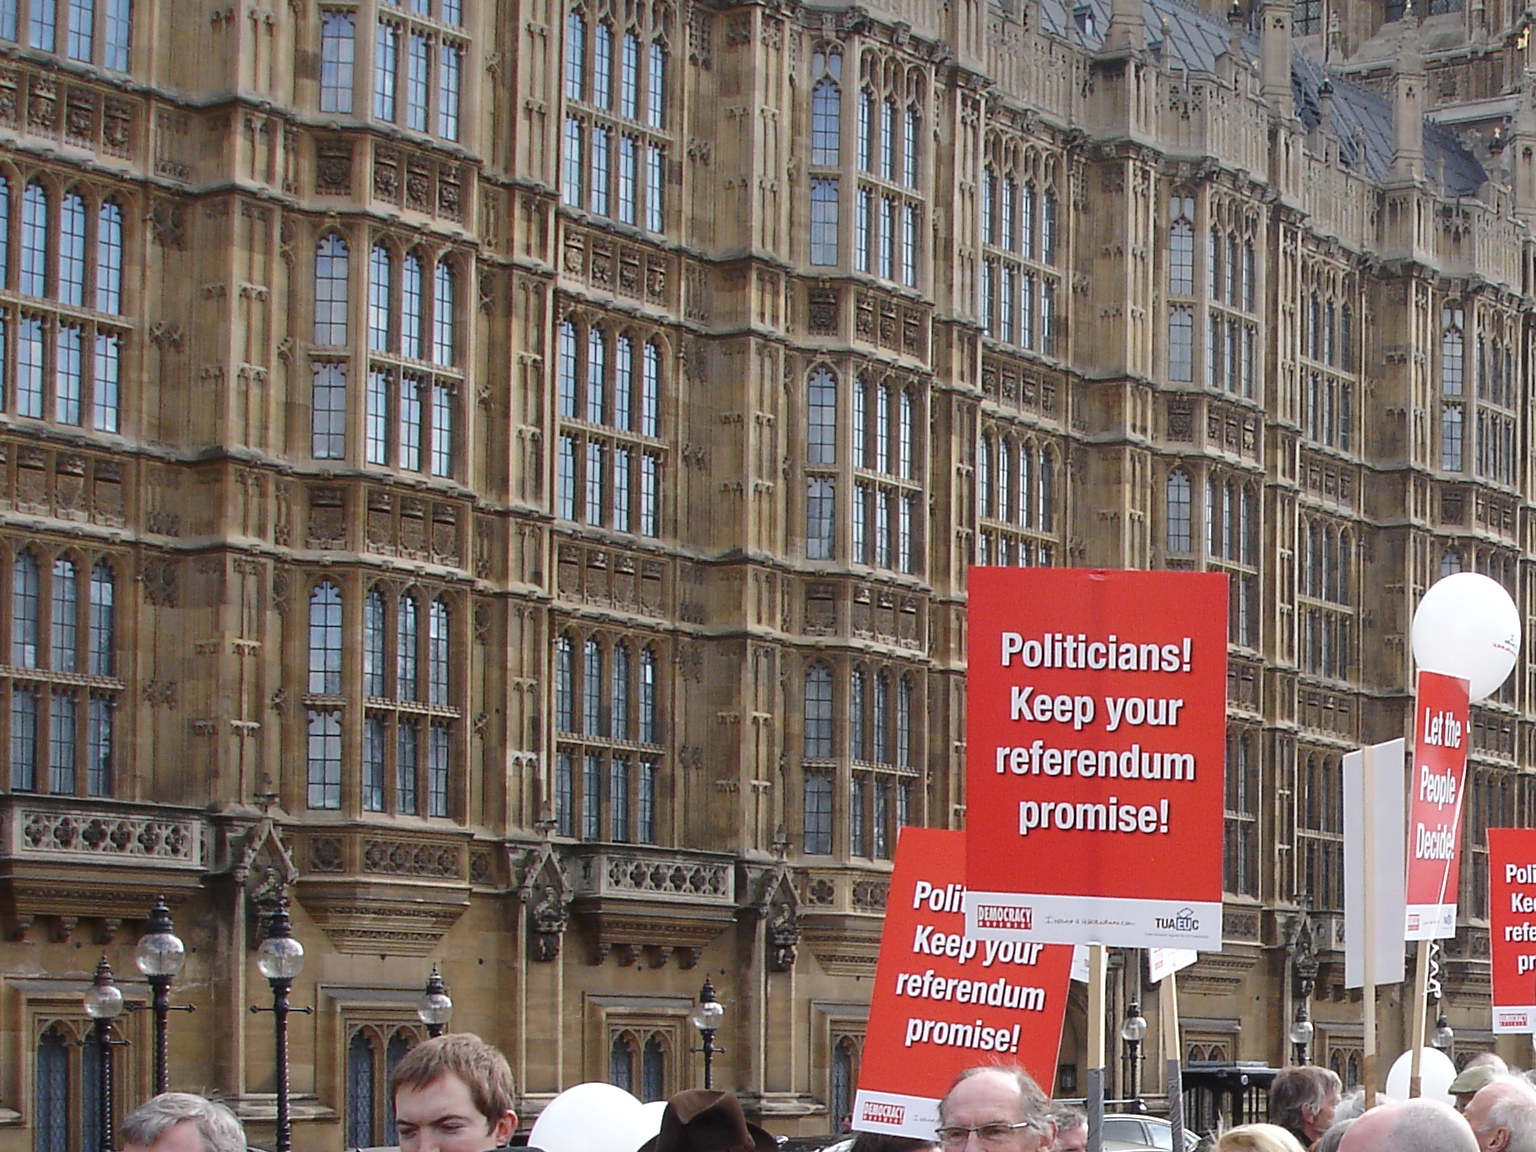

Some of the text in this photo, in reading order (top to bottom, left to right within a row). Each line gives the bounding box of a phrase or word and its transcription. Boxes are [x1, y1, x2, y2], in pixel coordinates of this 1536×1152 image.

[1000, 631, 1192, 673] Politicians!
[1010, 686, 1183, 732] Keep your
[1424, 707, 1461, 749] Let the
[996, 742, 1196, 781] referendum
[1420, 765, 1456, 811] People
[1018, 797, 1169, 835] promise!
[1416, 822, 1456, 860] Decide!
[978, 906, 1031, 923] DEMOCRACY
[913, 925, 1043, 967] Keep your
[896, 970, 1046, 1011] referendum
[905, 1018, 1021, 1053] promise!
